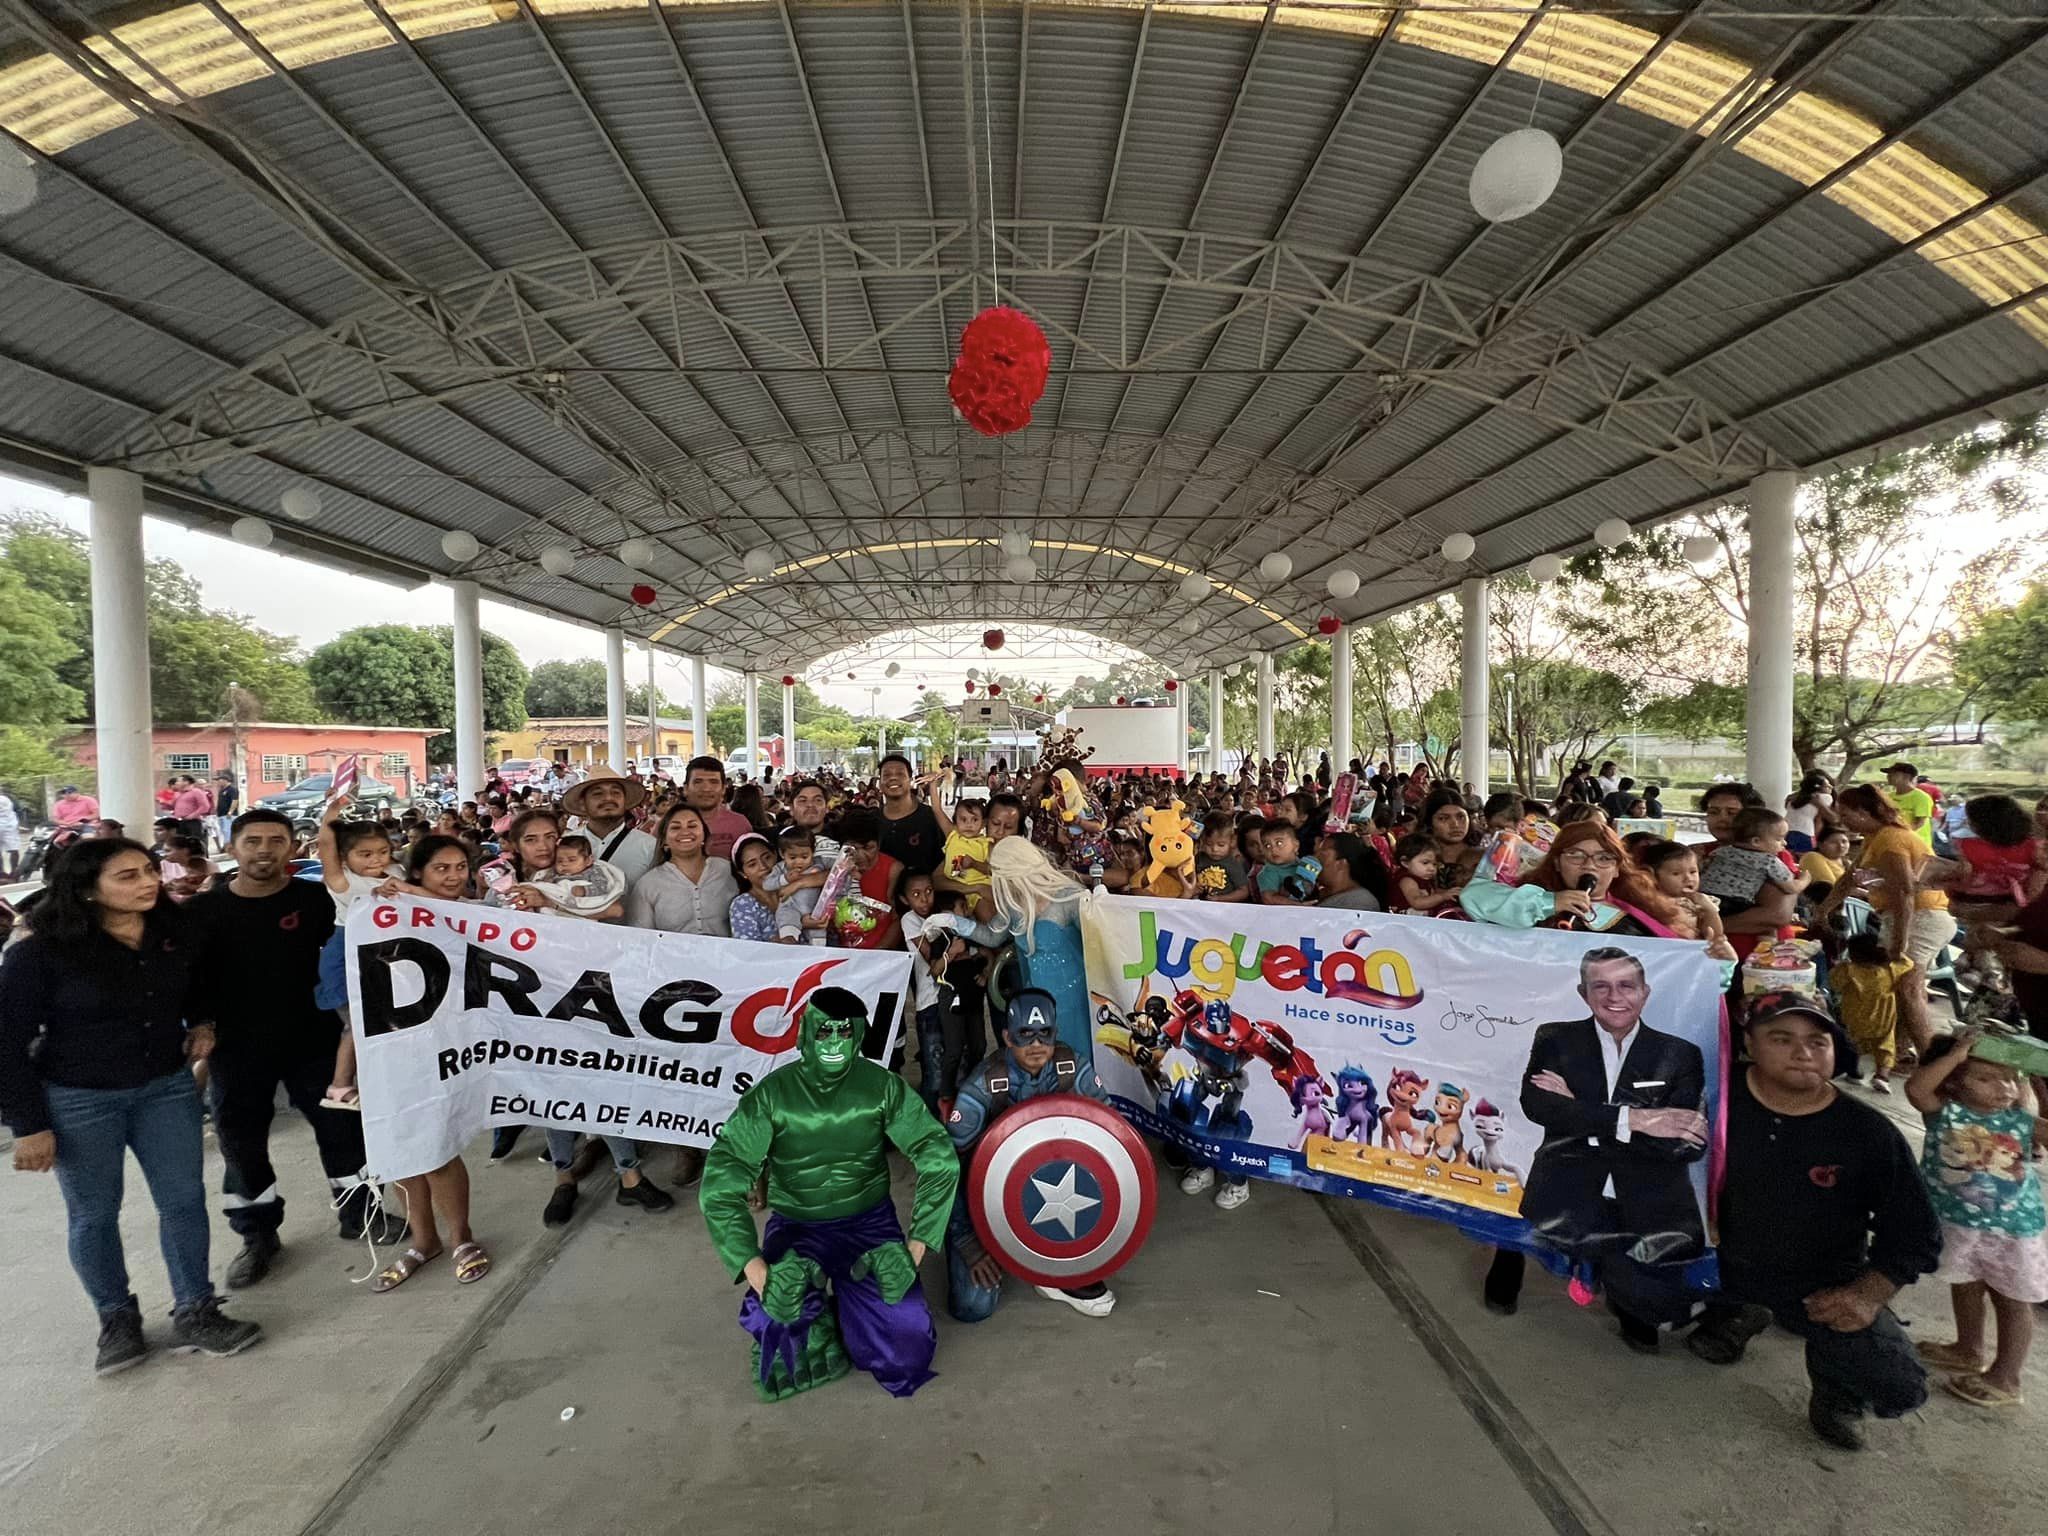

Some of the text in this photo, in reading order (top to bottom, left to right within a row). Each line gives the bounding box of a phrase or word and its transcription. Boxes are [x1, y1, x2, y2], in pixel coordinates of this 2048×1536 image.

[372, 905, 537, 952] GRUPO
[1124, 912, 1424, 1008] Juguetón
[1028, 1006, 1046, 1025] A
[1285, 1003, 1416, 1035] Hace sonrisas
[438, 1039, 722, 1088] Responsabilidad
[490, 1095, 587, 1123] EÓLICA
[598, 1105, 631, 1125] DE
